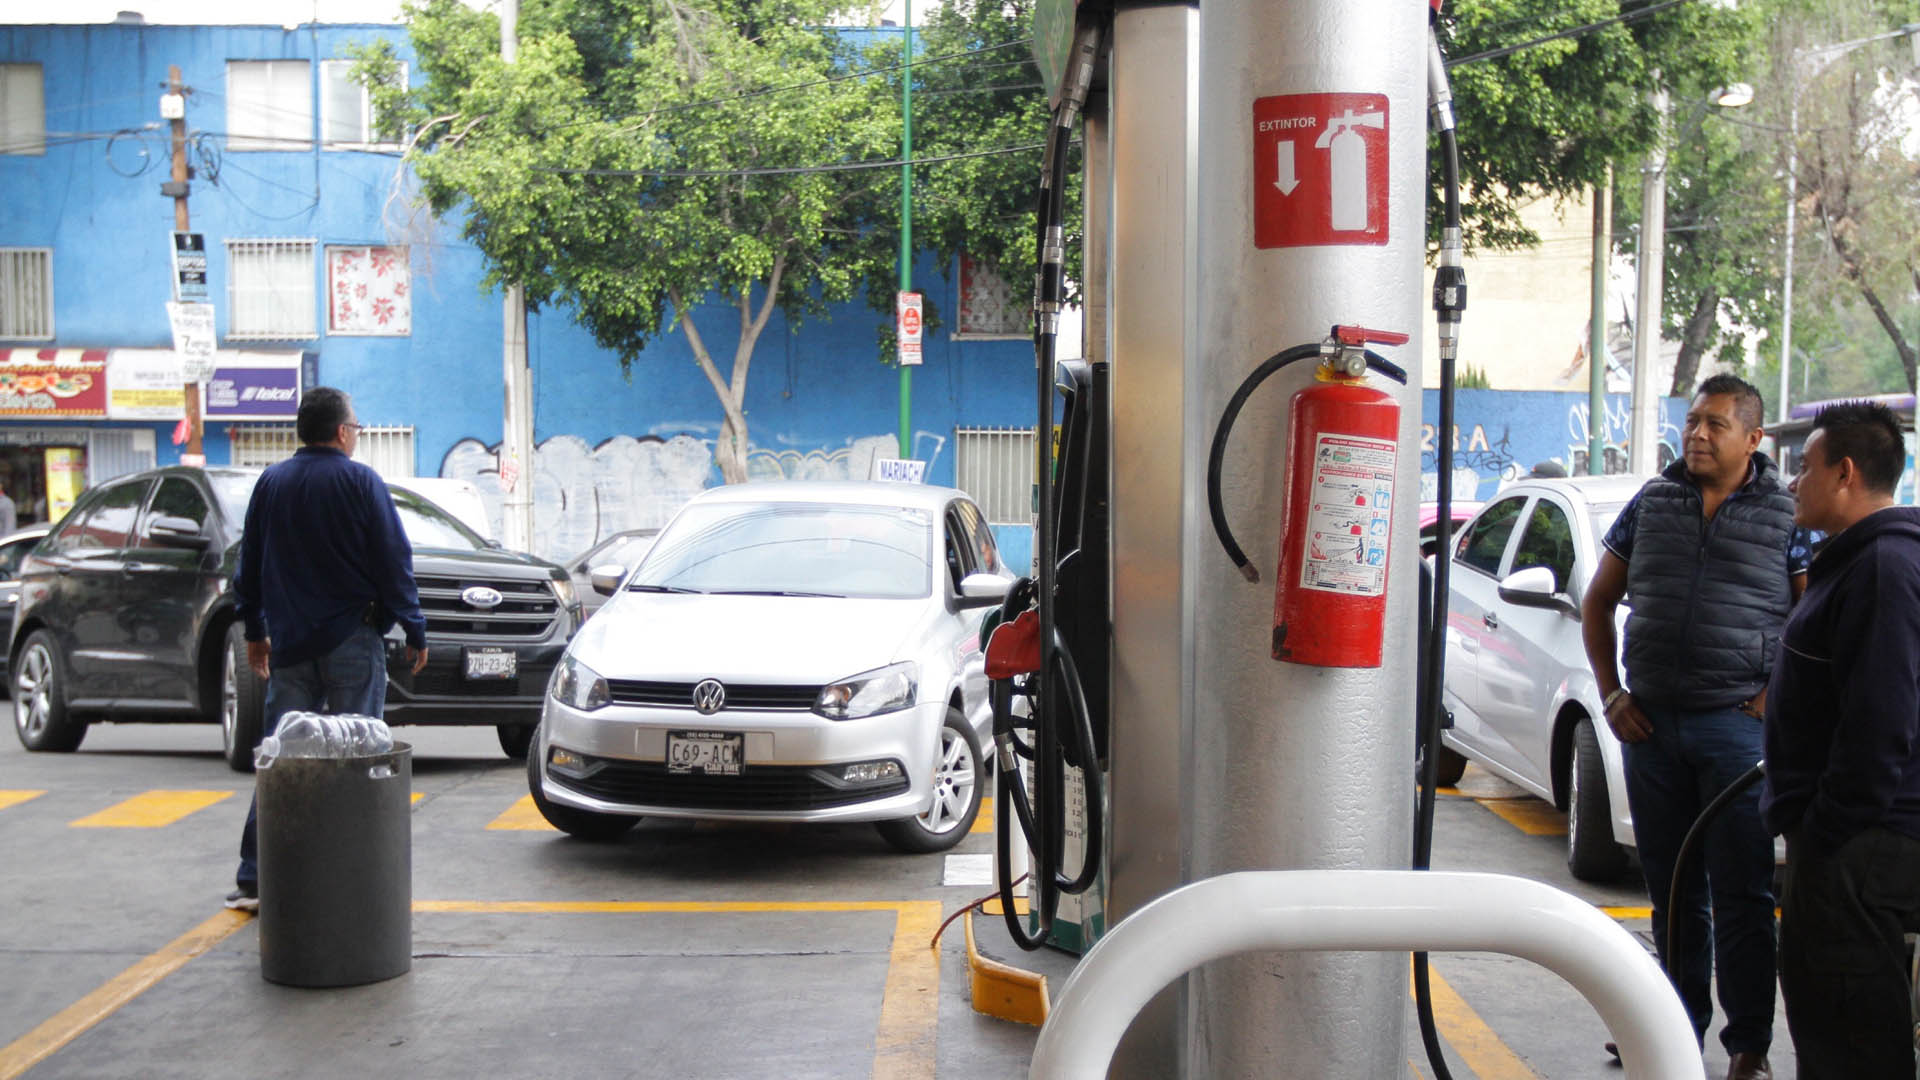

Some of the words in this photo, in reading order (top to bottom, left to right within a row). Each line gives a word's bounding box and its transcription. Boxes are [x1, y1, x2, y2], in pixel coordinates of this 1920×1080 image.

[1259, 117, 1316, 132] EXTINTOR
[255, 387, 296, 401] telcel
[694, 680, 725, 713] VW
